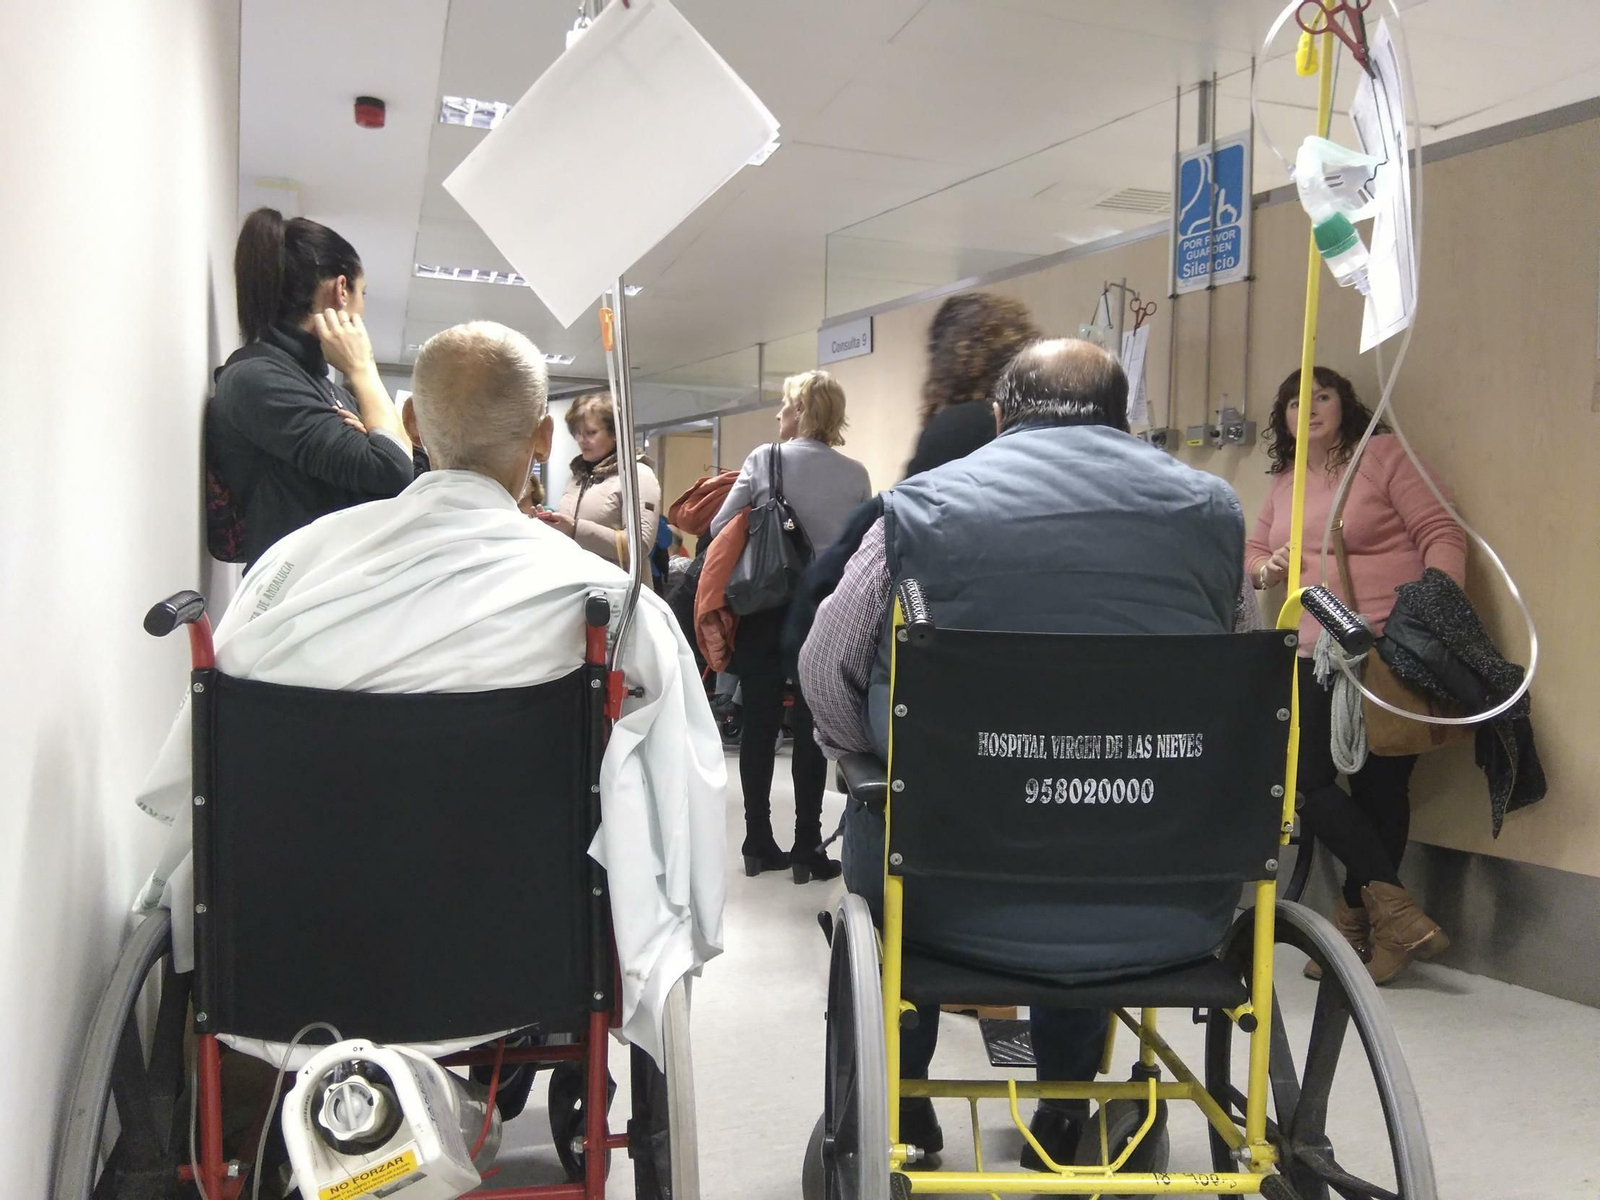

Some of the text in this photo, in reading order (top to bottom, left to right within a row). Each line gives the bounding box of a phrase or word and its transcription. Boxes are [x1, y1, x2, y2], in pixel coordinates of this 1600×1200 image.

[1183, 238, 1203, 251] POR
[832, 333, 867, 354] Consulta 9
[256, 599, 270, 612] DE
[978, 731, 1204, 760] HOSPITAL VIRGEN DE LAS NIEVES
[1024, 778, 1155, 805] 958020000
[330, 1156, 404, 1194] NO FORZAR
